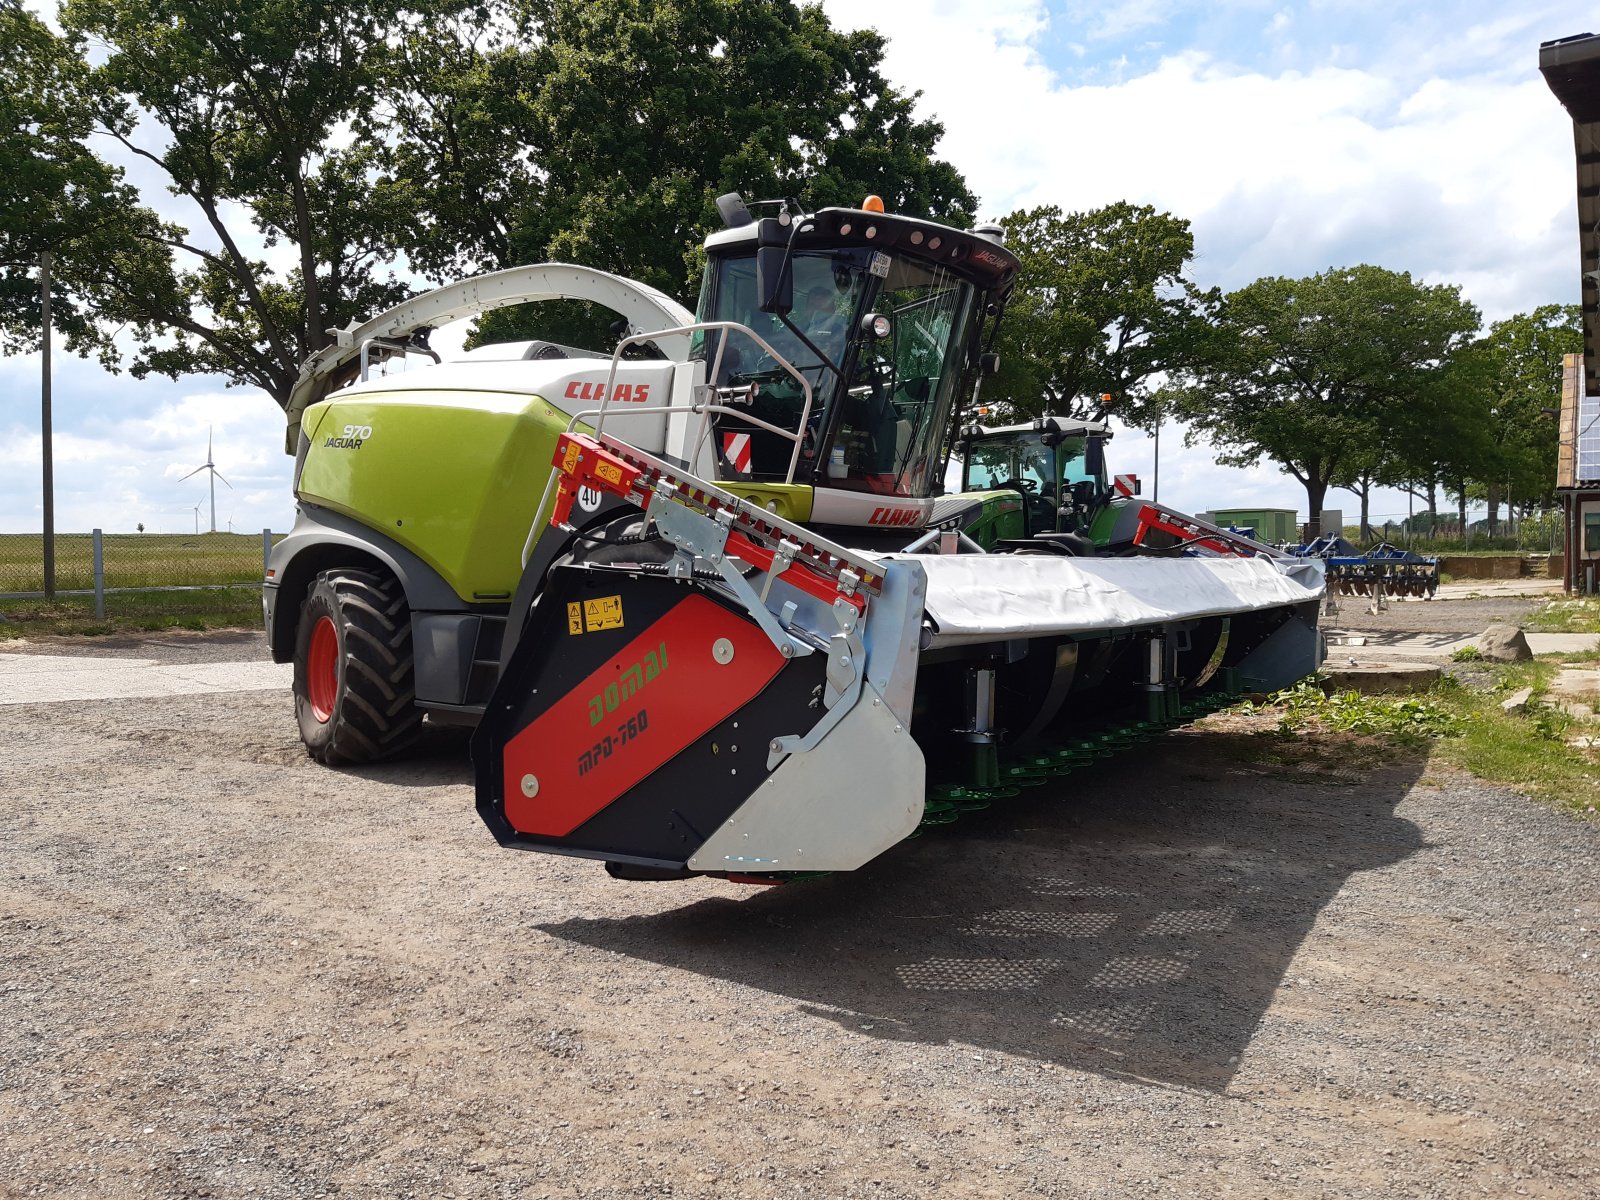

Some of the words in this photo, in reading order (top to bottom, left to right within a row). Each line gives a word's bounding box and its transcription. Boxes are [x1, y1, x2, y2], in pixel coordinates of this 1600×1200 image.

[975, 250, 1008, 269] JAGUAR
[564, 381, 650, 403] CLAAS
[342, 424, 373, 440] 970
[324, 437, 363, 450] JAGUAR
[867, 507, 921, 526] CLAAS
